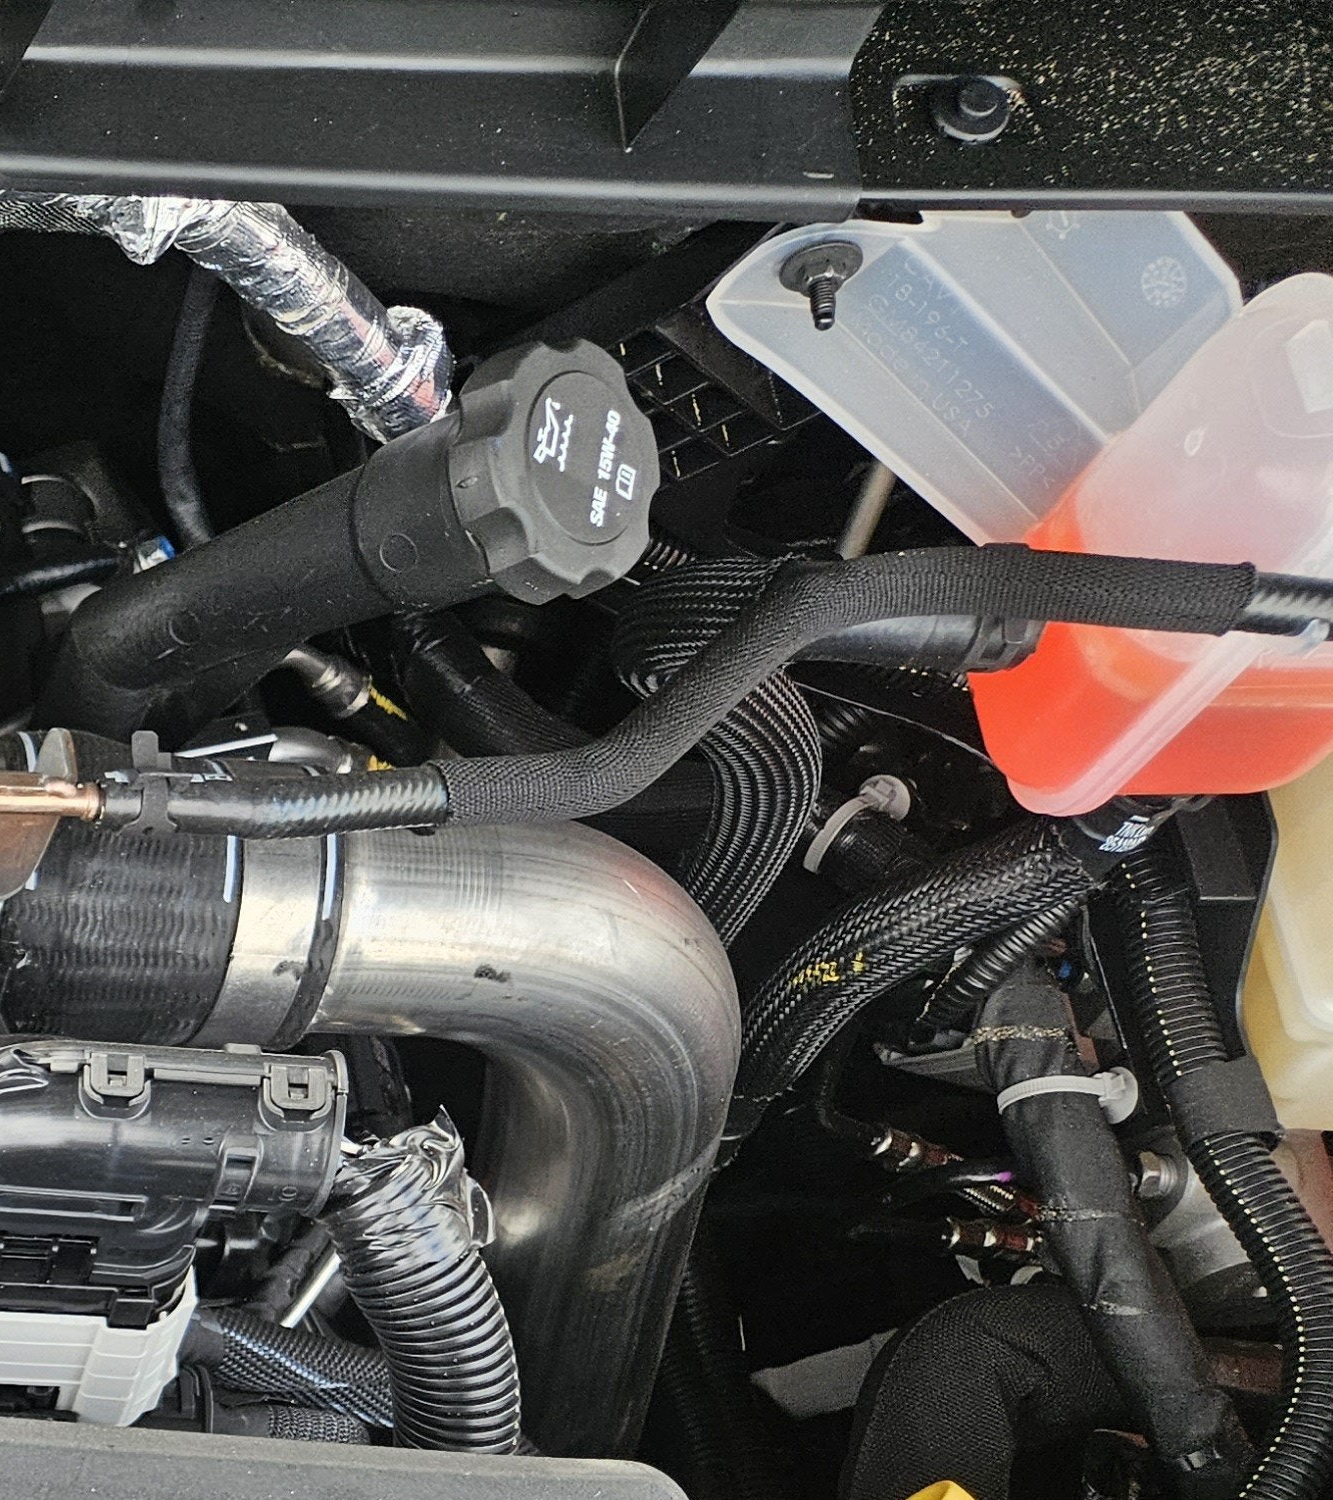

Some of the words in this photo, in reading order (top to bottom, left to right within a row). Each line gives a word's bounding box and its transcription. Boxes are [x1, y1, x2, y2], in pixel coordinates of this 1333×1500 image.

[931, 391, 973, 438] USA
[597, 409, 621, 480] 15W-40
[590, 486, 608, 527] SAE
